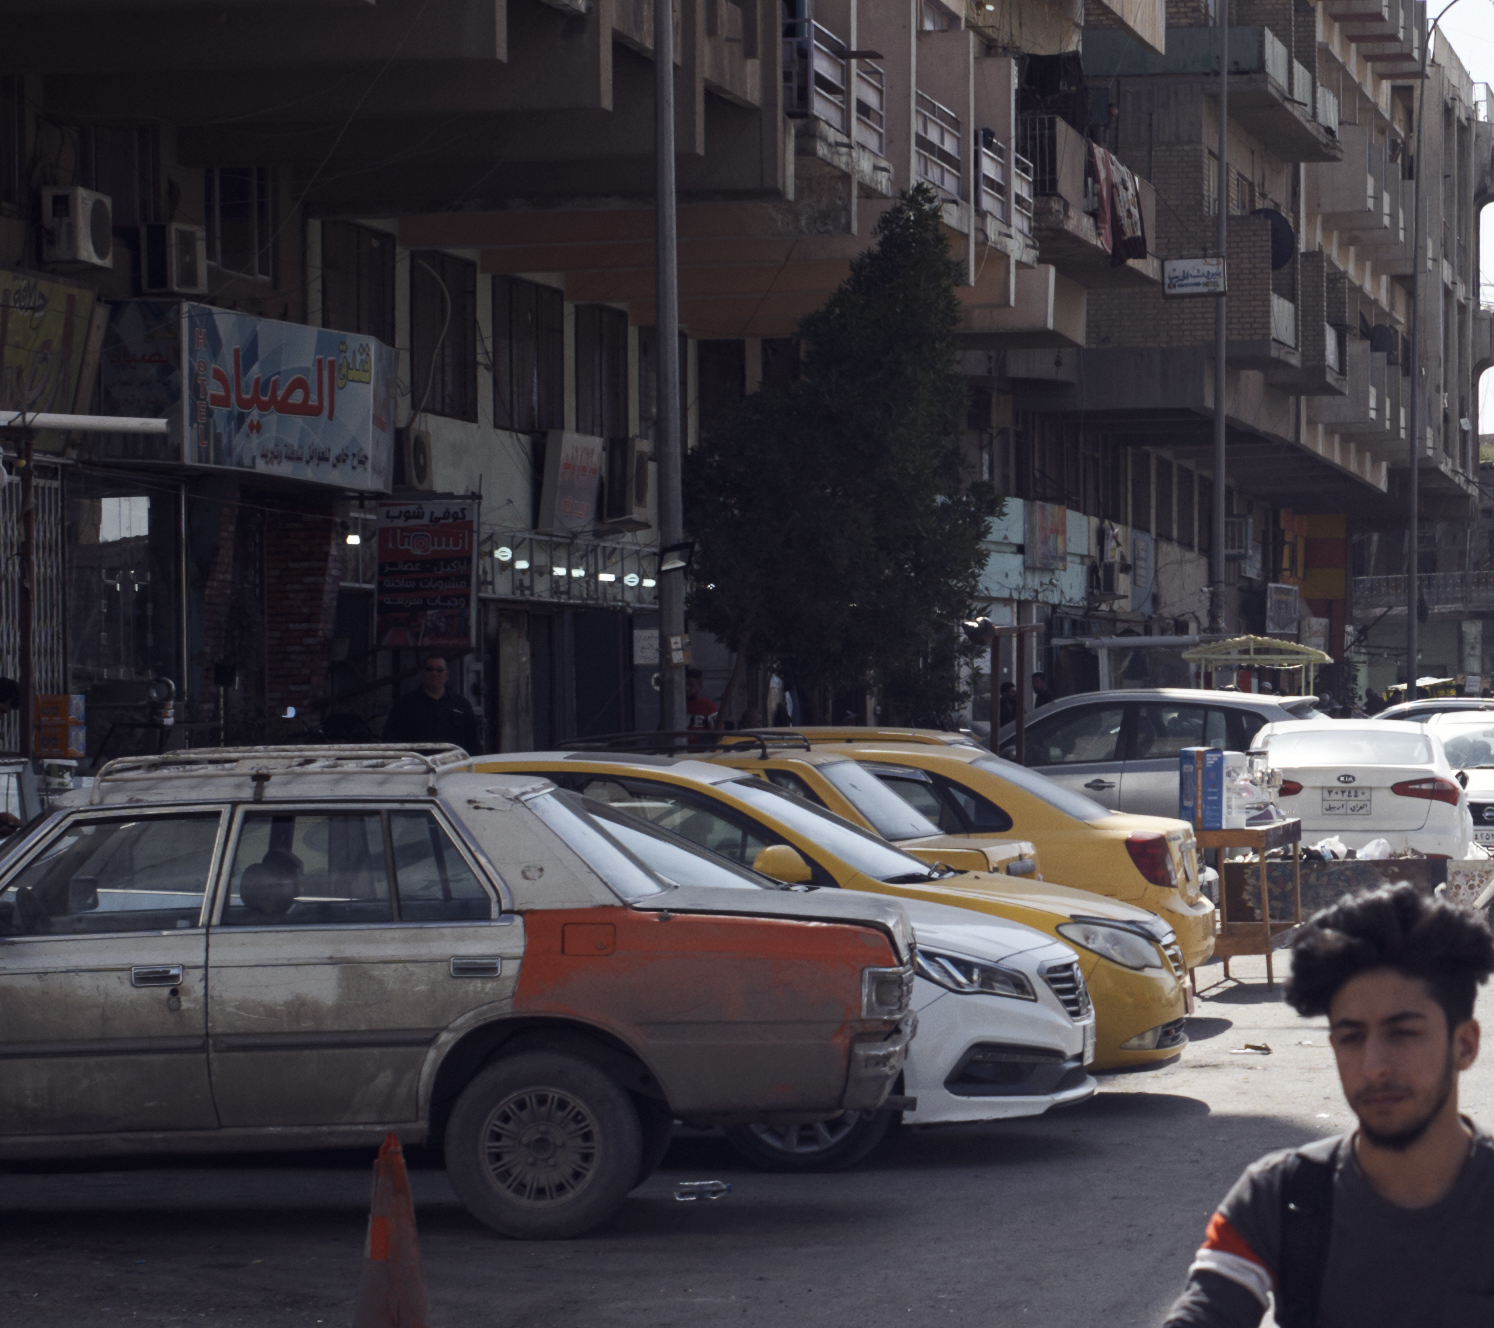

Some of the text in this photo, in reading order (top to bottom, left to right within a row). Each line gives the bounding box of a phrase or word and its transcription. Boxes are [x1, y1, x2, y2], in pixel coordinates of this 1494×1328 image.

[209, 345, 336, 434] الصياد
[337, 341, 372, 390] فندق
[385, 504, 425, 523] شوب
